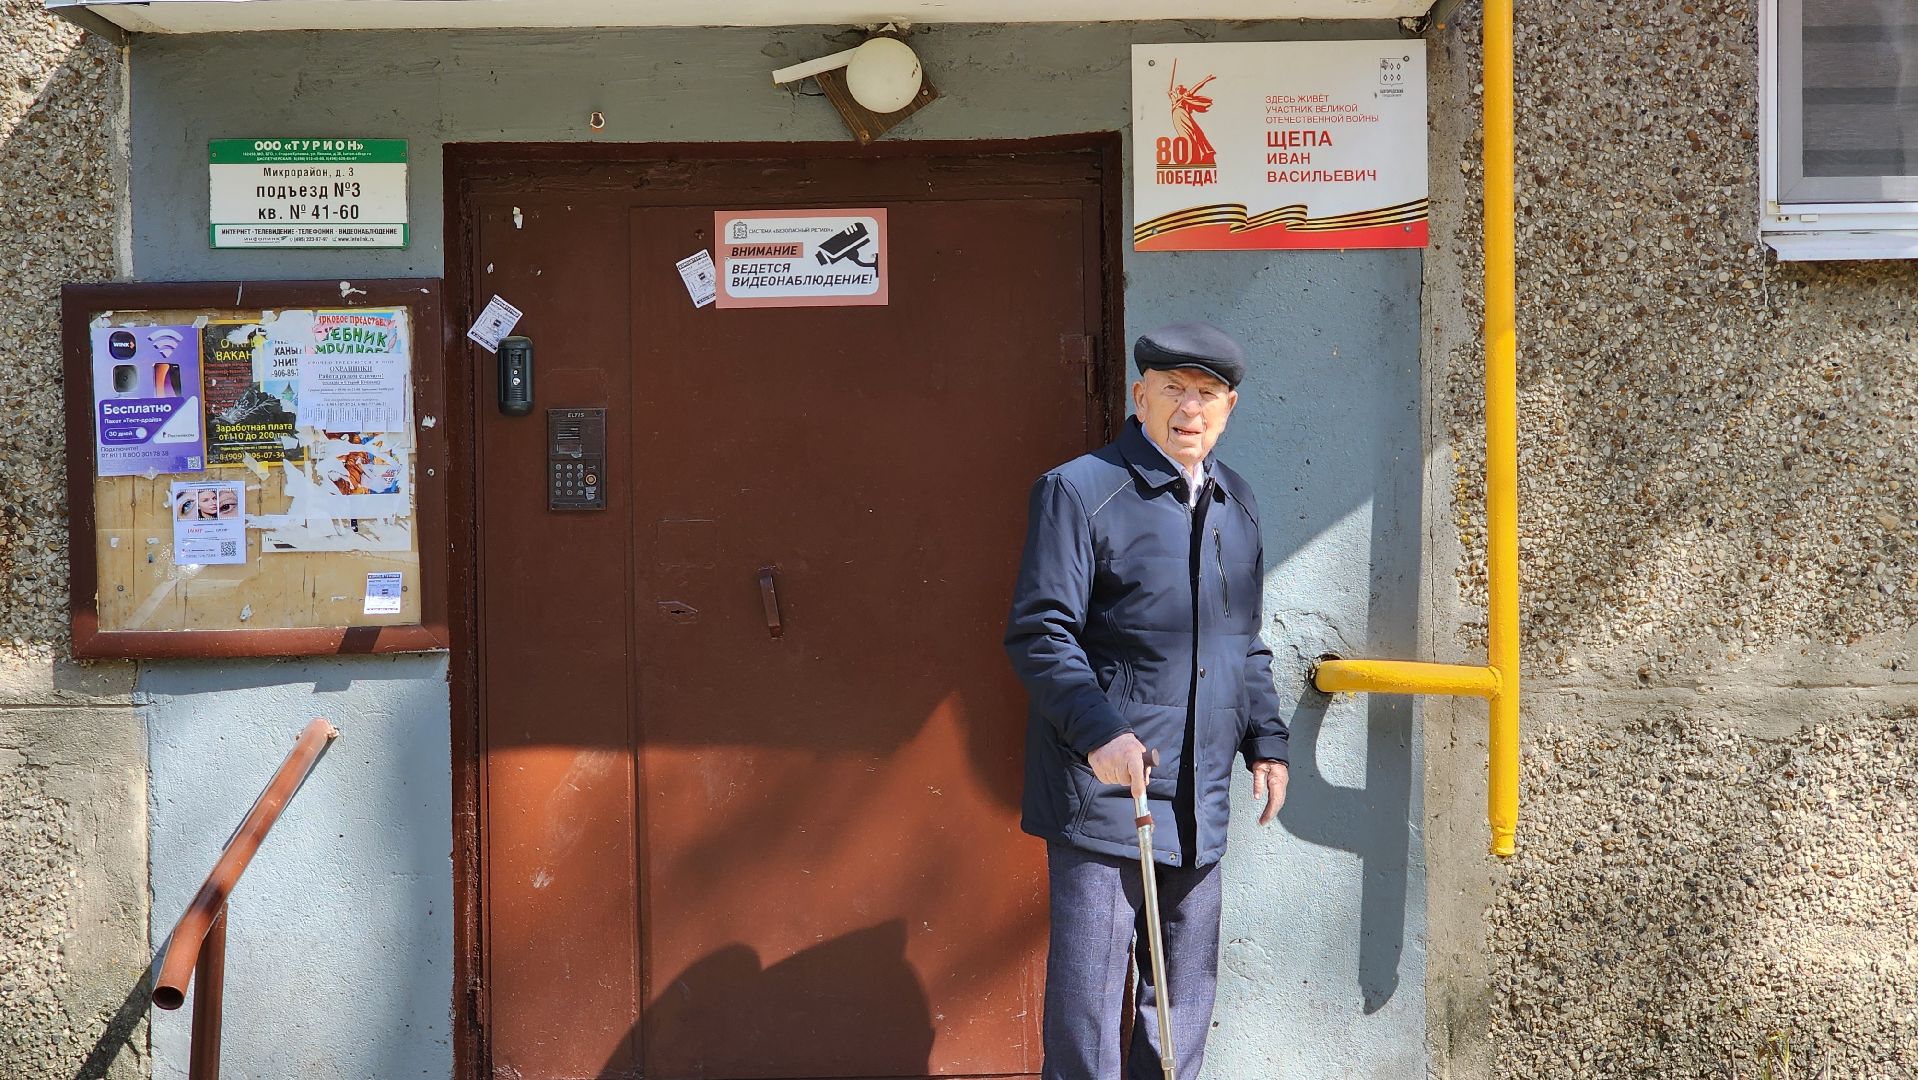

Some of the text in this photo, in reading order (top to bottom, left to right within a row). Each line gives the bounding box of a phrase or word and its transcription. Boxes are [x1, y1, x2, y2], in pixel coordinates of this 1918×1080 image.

[1298, 94, 1329, 103] ЖИВЁТ
[1266, 103, 1358, 113] УЧАСТНИК ВЕЛИКОЙ
[1266, 113, 1379, 124] ОТЕЧЕСТВЕННОЙ ВОЙНЫ
[254, 140, 364, 151] ООО «ТУРИОН»
[1266, 130, 1333, 150] ЩЕПА
[1156, 136, 1192, 165] 80
[1267, 152, 1311, 165] ИВАН
[263, 167, 354, 179] Микрорайон, д. 3
[1156, 169, 1218, 187] ПОБЕДА!
[1267, 169, 1377, 183] ВАСИЛЬЕВИЧ
[256, 182, 361, 200] подъезд №3
[258, 204, 360, 220] кв. № 41-60
[221, 228, 251, 236] ИНТЕРНЕТ
[254, 228, 295, 236] ТЕЛЕВИДЕНИЕ
[298, 228, 334, 236] ТЕЛЕФОНИЯ
[731, 245, 797, 257] ВНИМАНИЕ
[731, 263, 791, 275] ВЕДЕТСЯ
[731, 274, 873, 288] ВИДЕОНАБЛЮДЕНИЕ!
[323, 326, 388, 348] ЕБНИК
[103, 403, 172, 415] Бесплатно
[215, 423, 293, 433] Заработная плата
[245, 433, 257, 441] до
[259, 431, 275, 439] 200
[248, 451, 285, 459] 95-07-34
